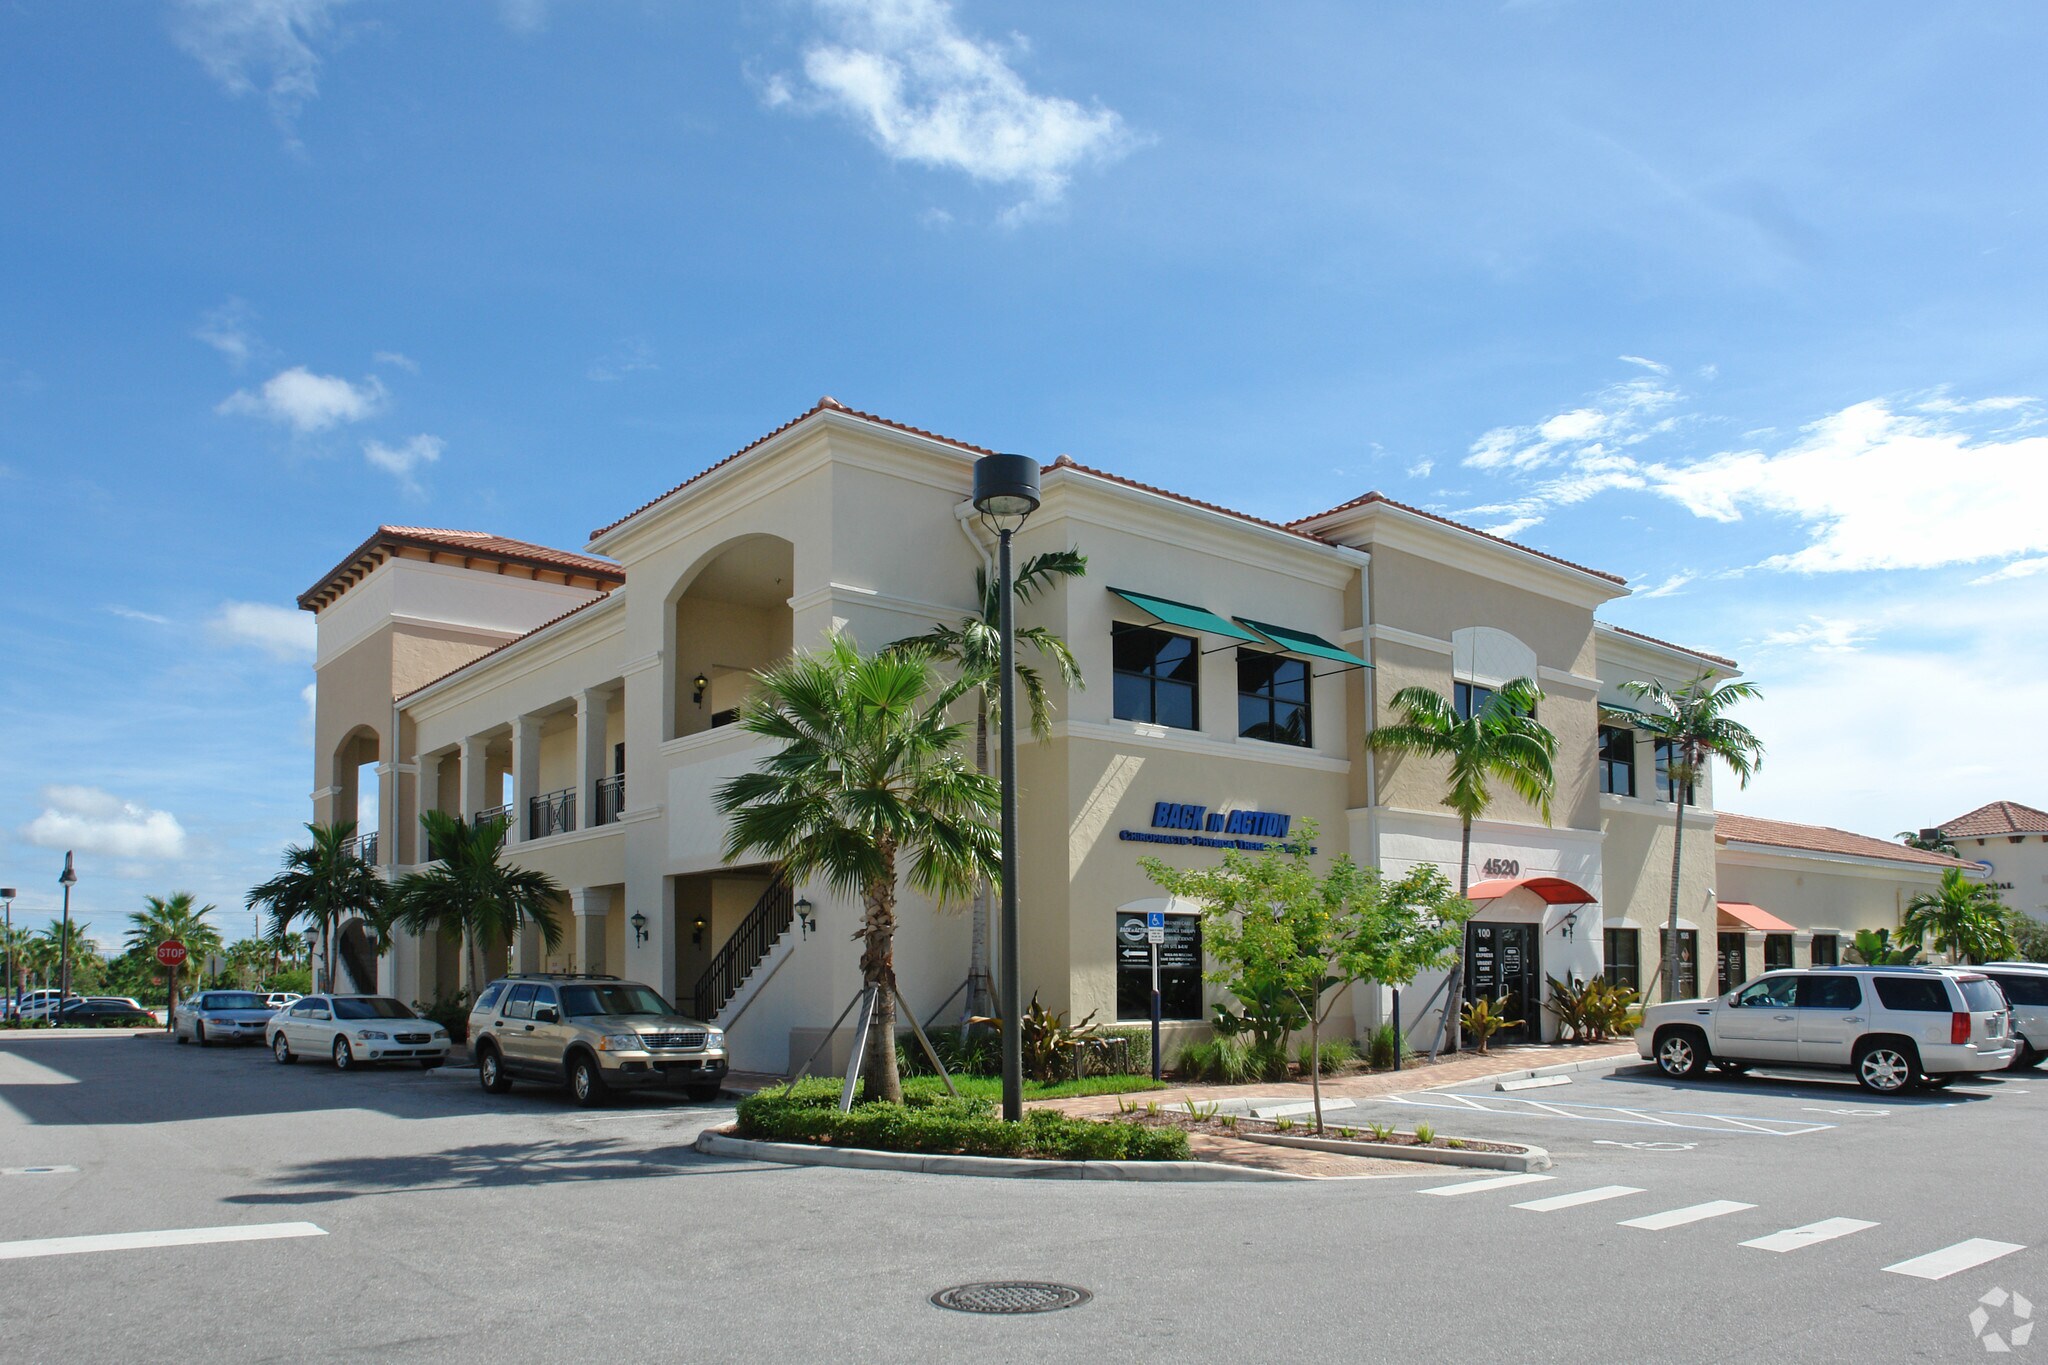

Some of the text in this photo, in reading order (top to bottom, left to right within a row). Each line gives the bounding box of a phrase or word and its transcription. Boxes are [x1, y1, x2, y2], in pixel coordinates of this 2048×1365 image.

[1151, 802, 1291, 838] BACK IN ACTION
[1483, 858, 1520, 877] 4520
[1477, 928, 1491, 938] 100
[158, 948, 186, 958] STOP
